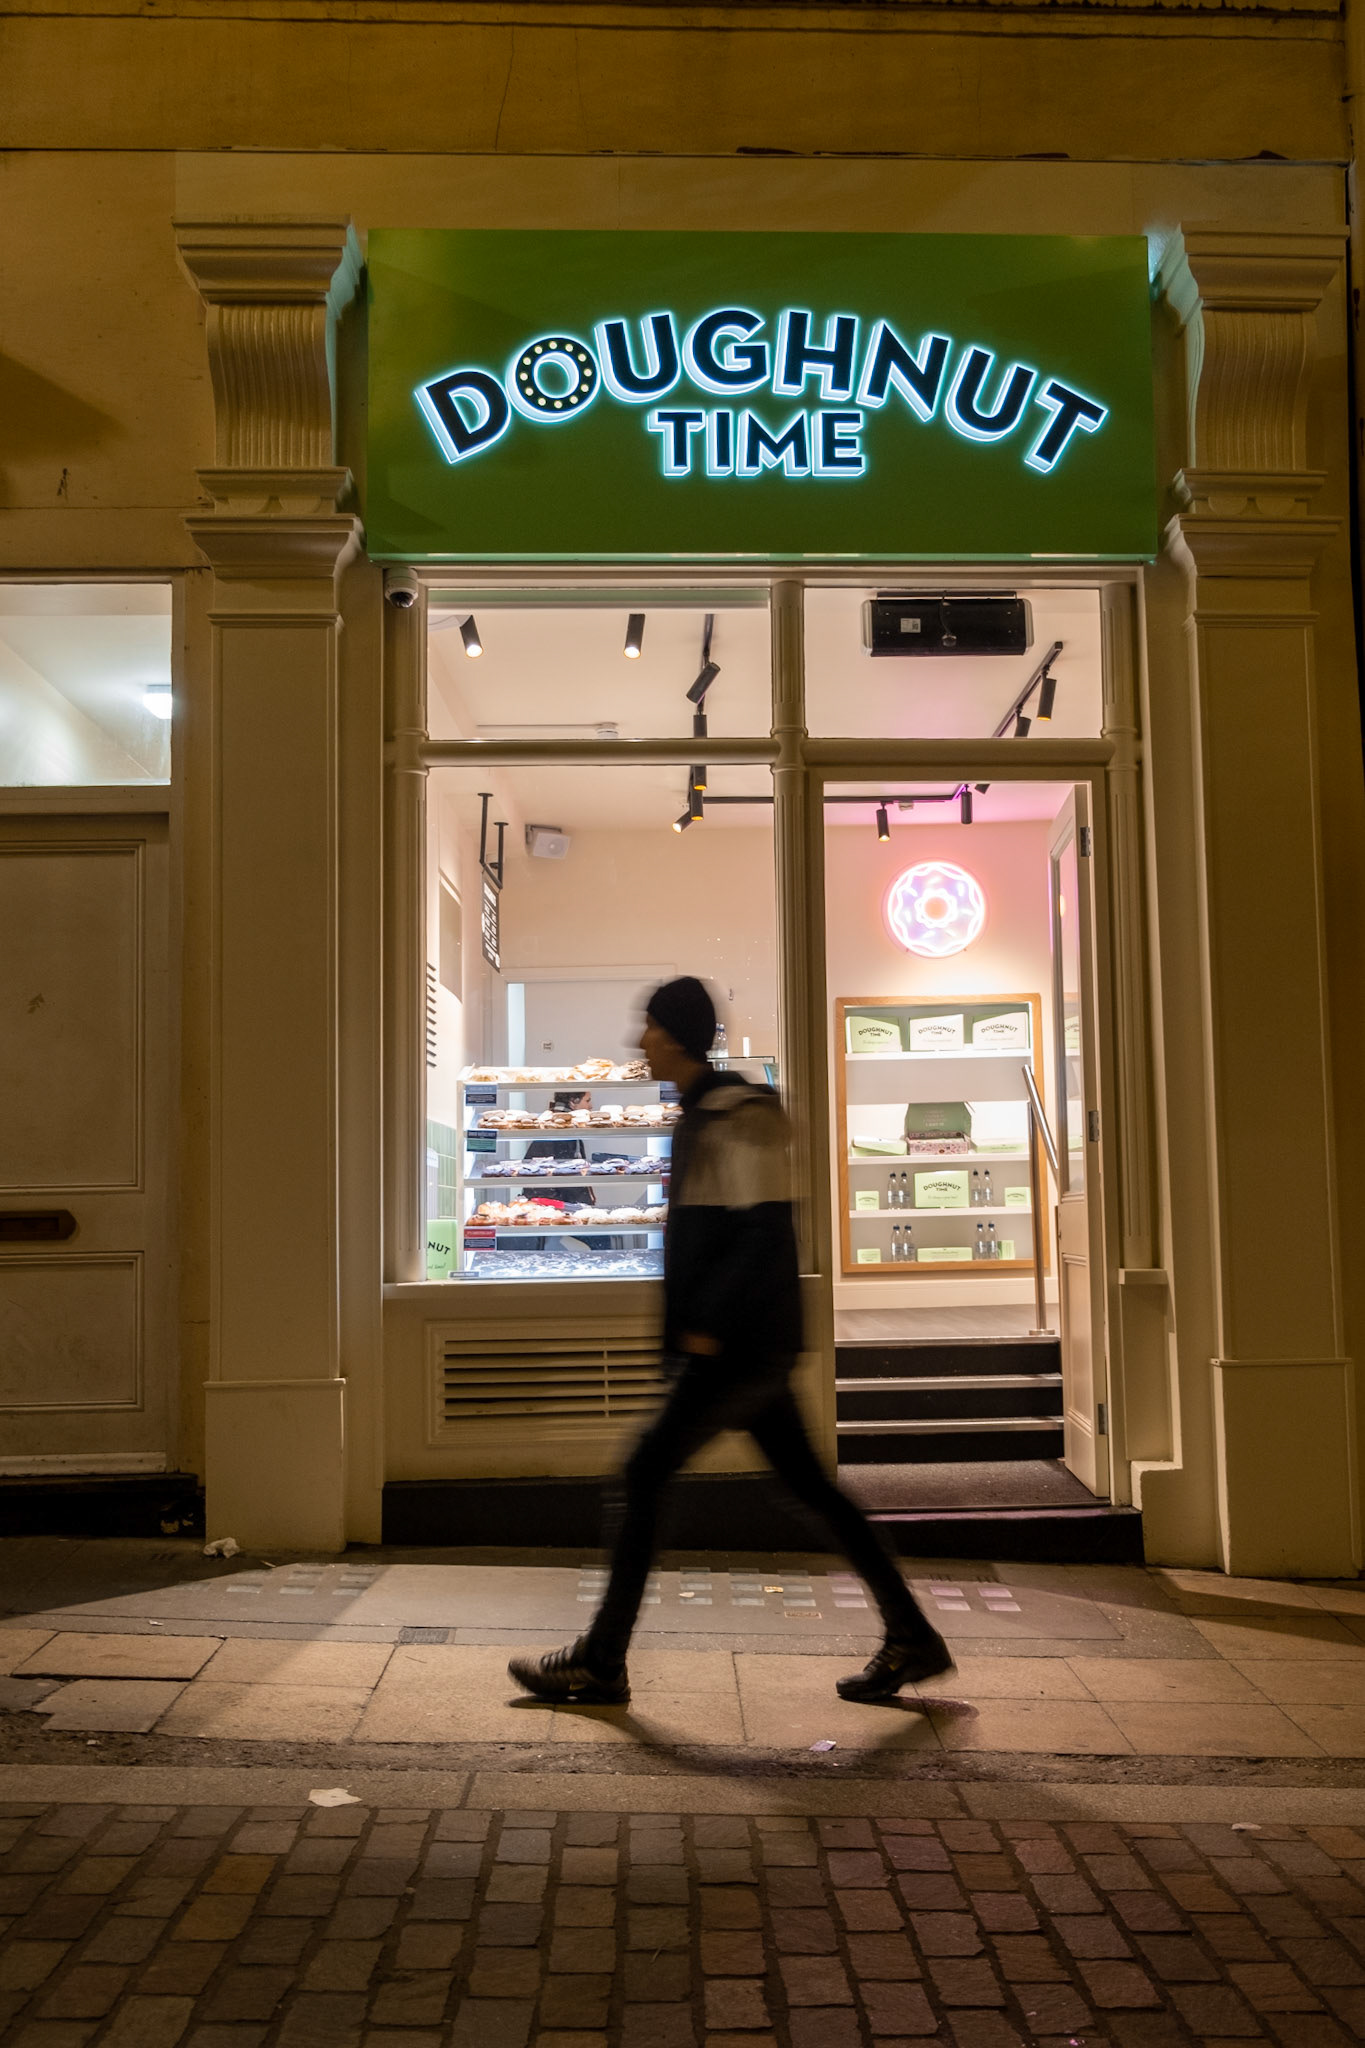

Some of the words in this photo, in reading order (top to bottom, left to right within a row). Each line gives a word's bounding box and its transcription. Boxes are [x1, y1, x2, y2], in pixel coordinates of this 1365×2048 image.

[413, 307, 1109, 474] DOUGHNUT
[645, 409, 867, 478] TIME
[858, 1026, 893, 1037] DOUGHNUT
[918, 1025, 956, 1035] DOUGHNUT
[980, 1023, 1018, 1033] DOUGHNUT
[923, 1181, 961, 1191] DOUGHNUT
